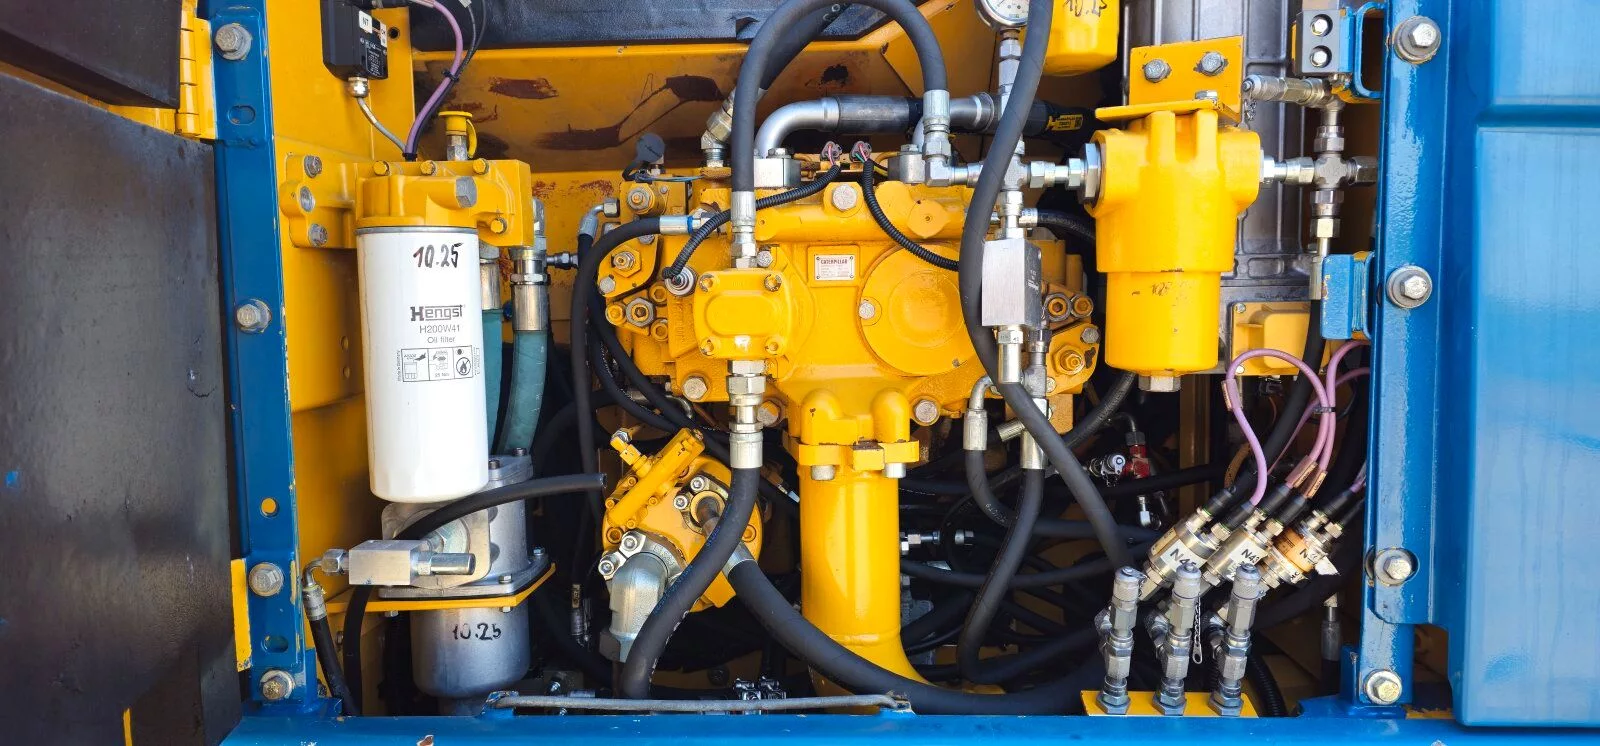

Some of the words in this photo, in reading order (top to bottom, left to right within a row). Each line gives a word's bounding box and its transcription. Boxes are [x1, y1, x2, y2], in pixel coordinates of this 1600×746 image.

[413, 242, 463, 268] 10.25
[410, 304, 463, 321] Hengst
[419, 324, 460, 334] H200W41
[440, 335, 455, 343] filter
[452, 623, 502, 641] 10.25
